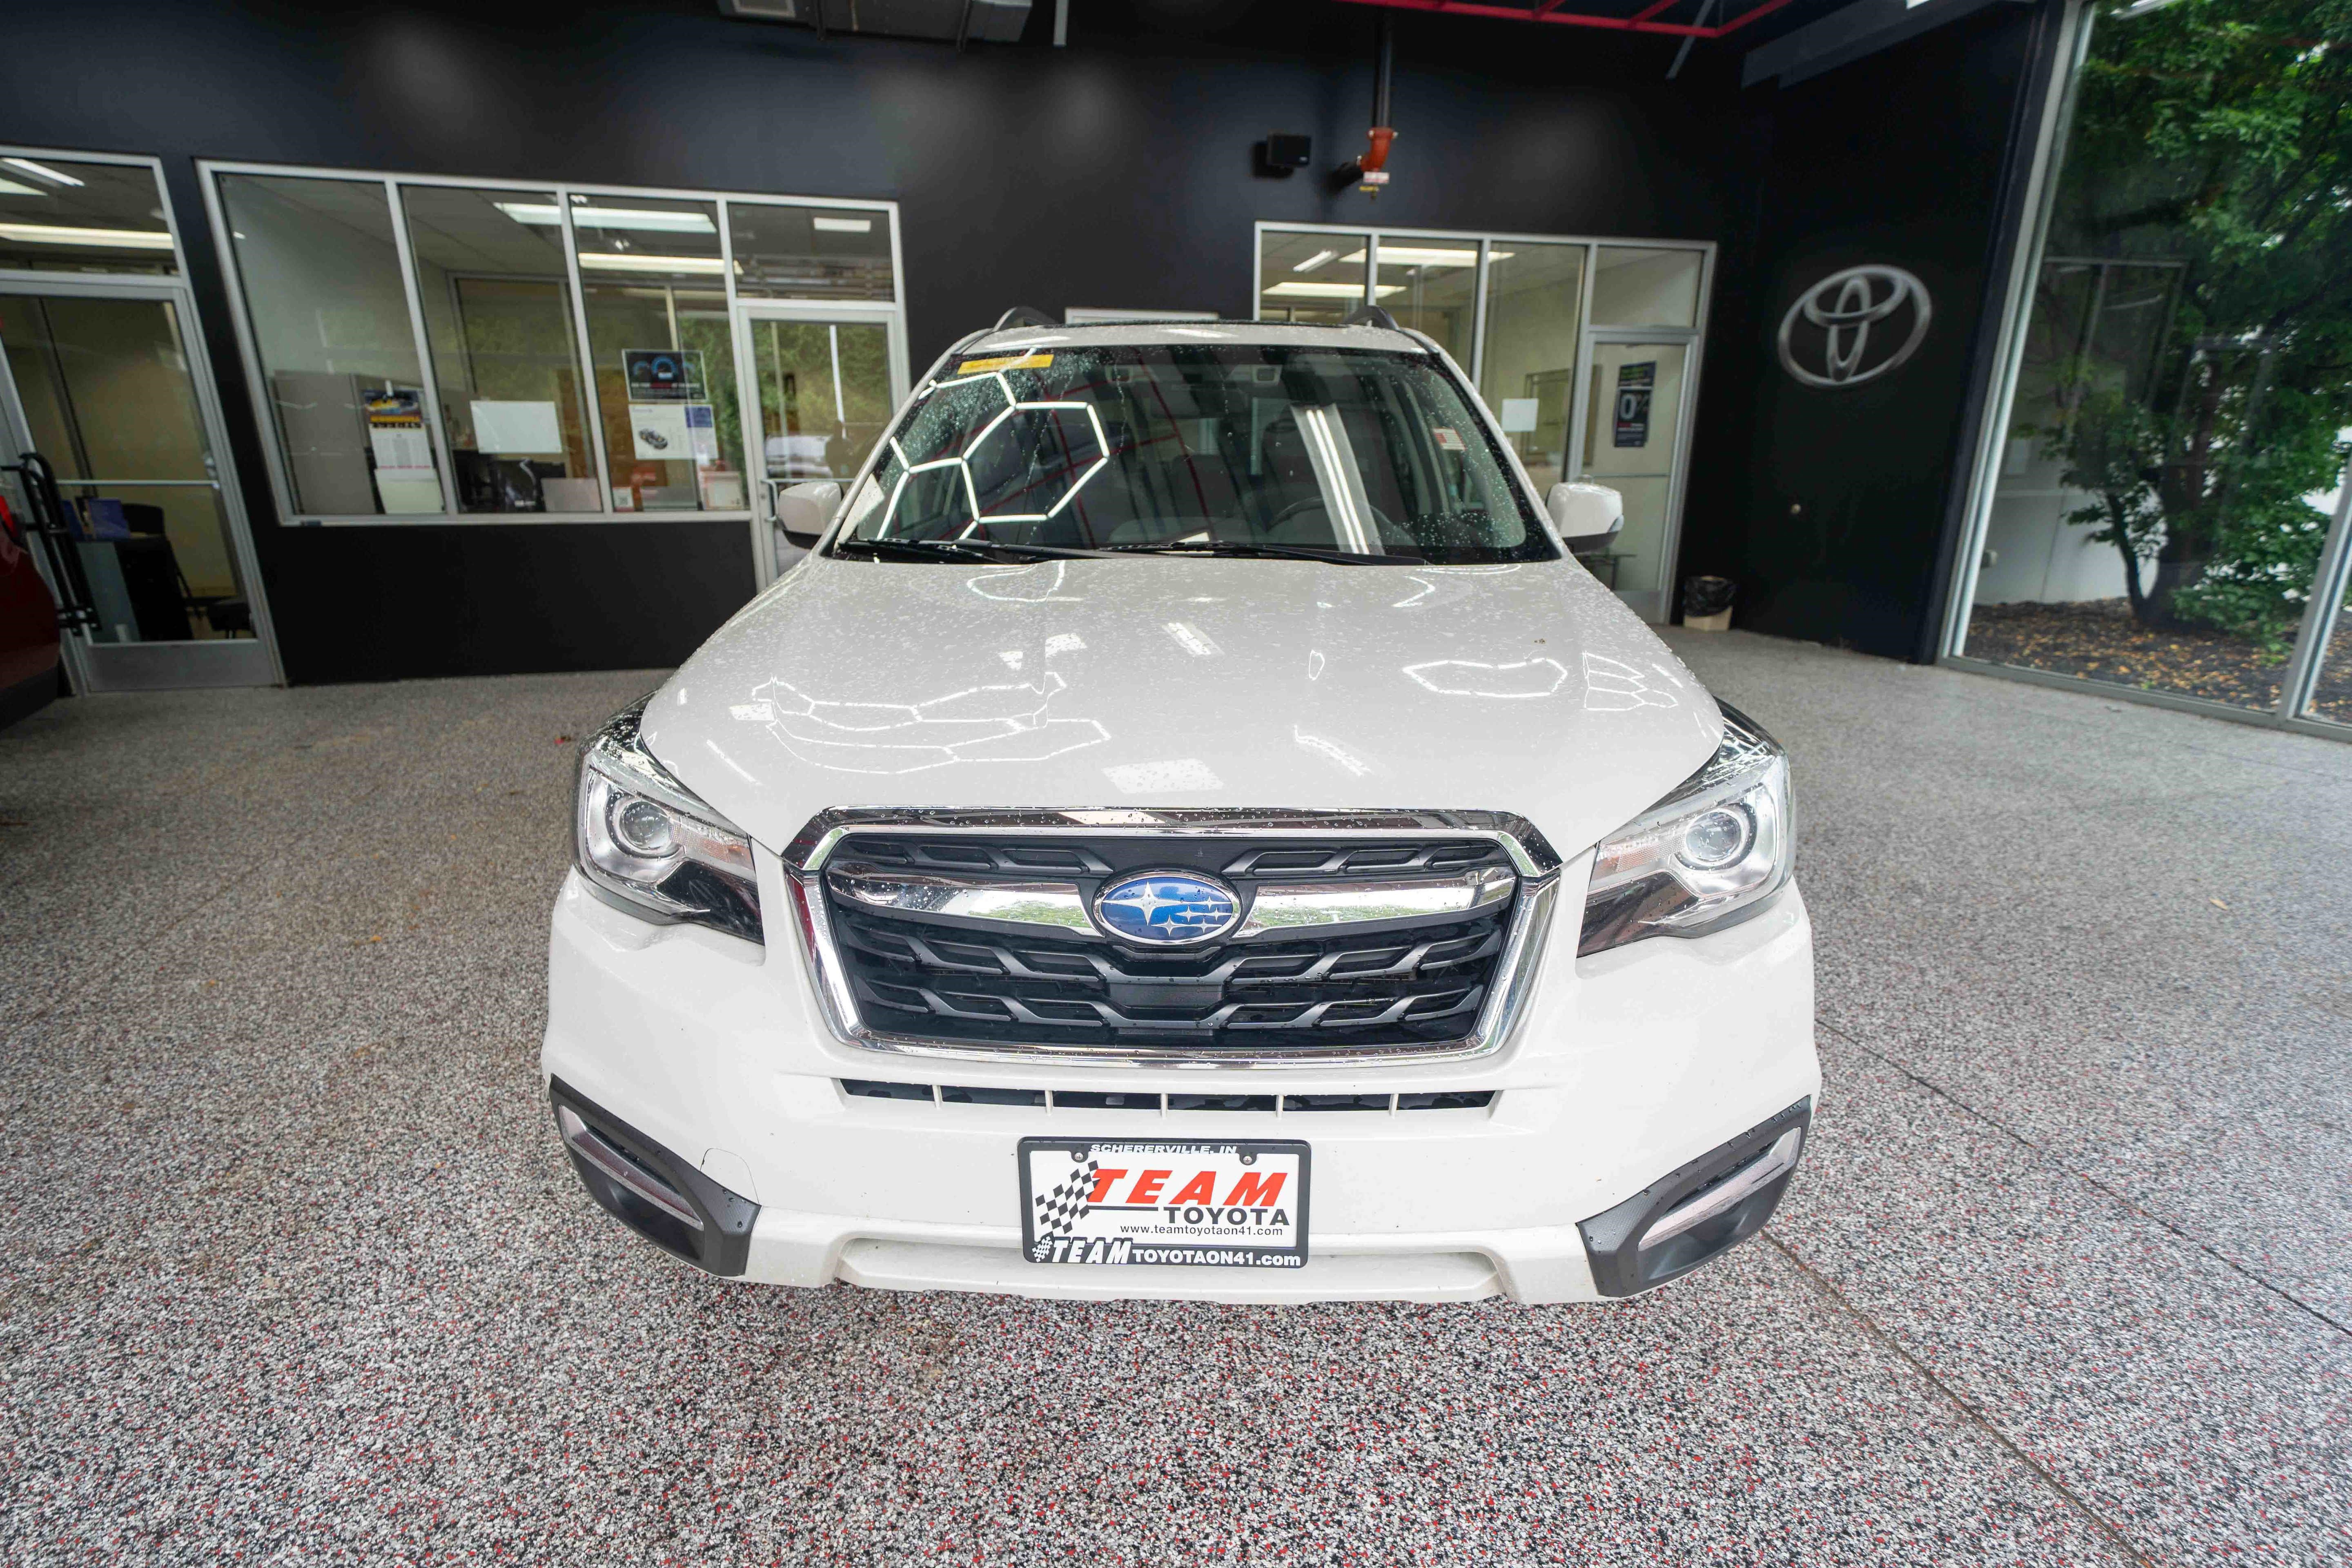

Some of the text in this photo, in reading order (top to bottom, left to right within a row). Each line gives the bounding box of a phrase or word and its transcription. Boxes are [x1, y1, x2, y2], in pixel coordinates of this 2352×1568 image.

[1219, 1145, 1237, 1154] IN
[1087, 1168, 1288, 1207] TEAM
[1163, 1206, 1290, 1226] TOYOTA
[1120, 1224, 1283, 1236] www.teamtoyotaon41.com
